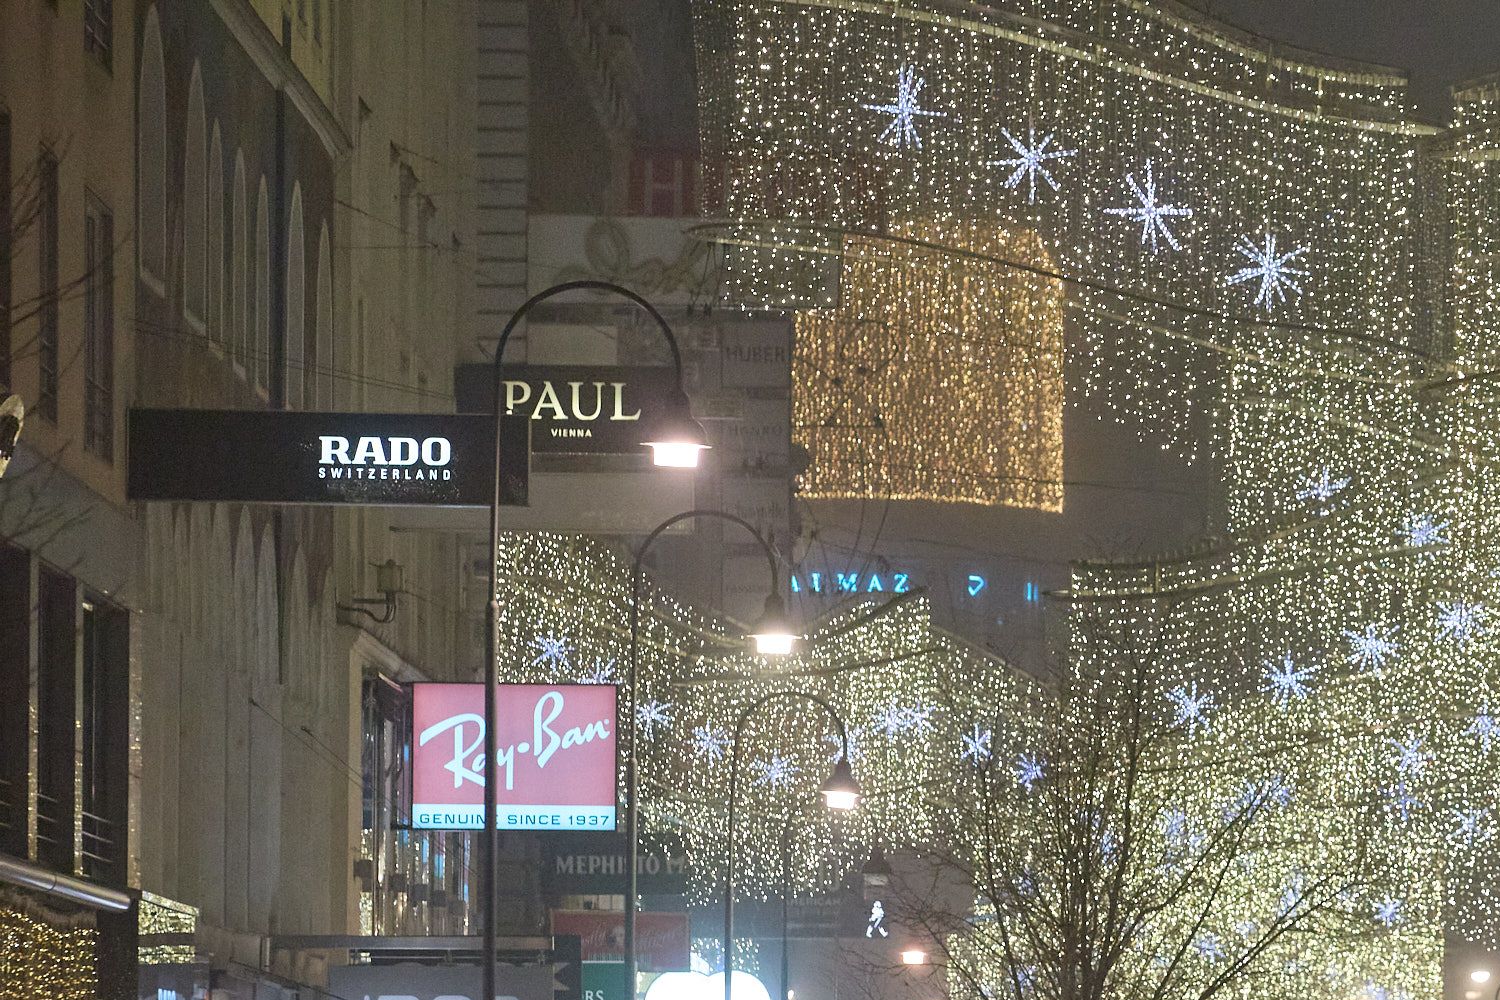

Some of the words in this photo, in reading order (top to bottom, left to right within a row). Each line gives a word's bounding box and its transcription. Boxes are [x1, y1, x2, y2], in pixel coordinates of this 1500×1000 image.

[502, 381, 641, 422] PAUL
[551, 428, 592, 438] VIENNA
[319, 436, 451, 465] RADO
[319, 468, 451, 481] SWITZERLAND
[419, 813, 498, 825] GENUIN
[507, 814, 561, 826] SINCE
[568, 815, 610, 826] 1937
[556, 855, 660, 875] MEPHITO
